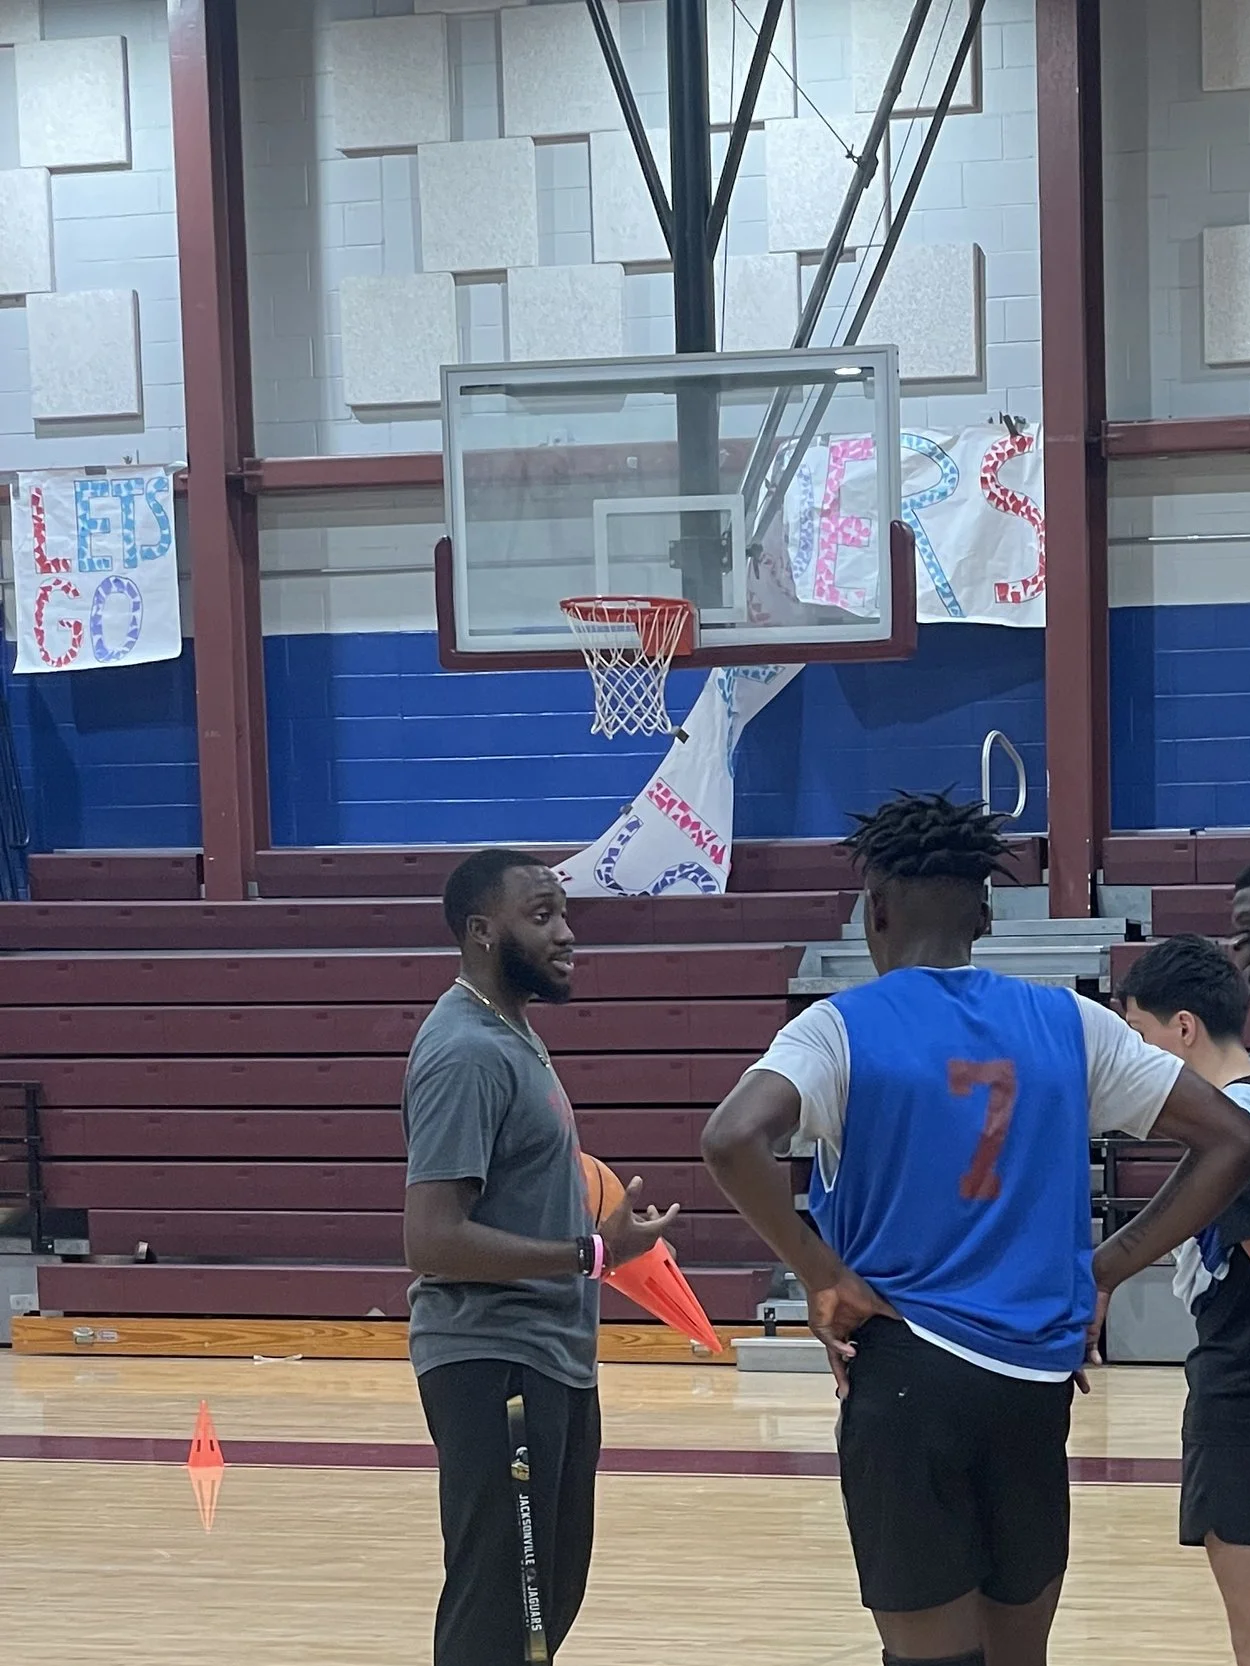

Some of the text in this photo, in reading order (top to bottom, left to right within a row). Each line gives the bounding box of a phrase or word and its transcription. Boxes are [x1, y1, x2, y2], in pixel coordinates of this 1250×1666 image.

[30, 475, 172, 574] LETS
[33, 575, 144, 668] GO
[947, 1059, 1017, 1199] 7
[519, 1493, 535, 1566] JACKSONVILLE
[527, 1585, 543, 1632] JAGUARS
